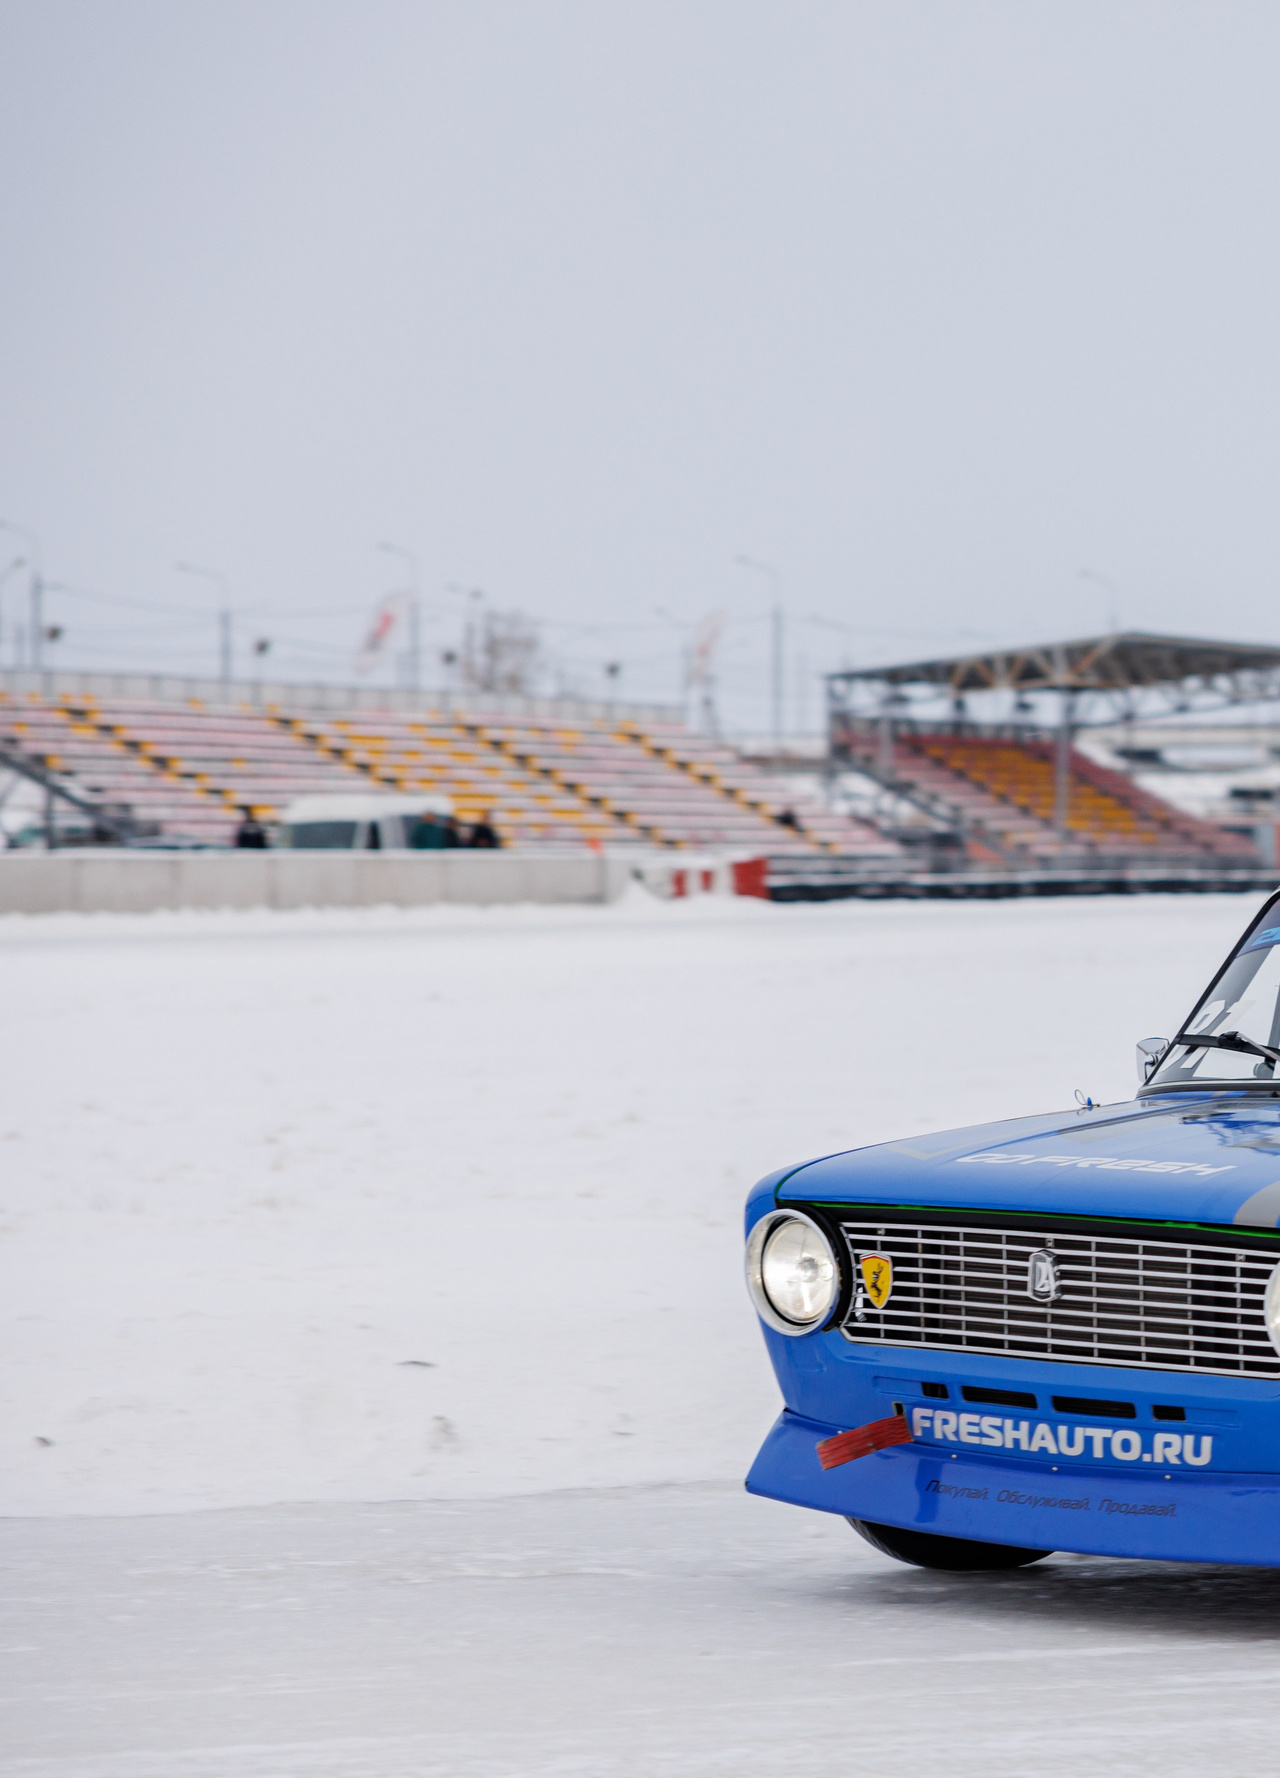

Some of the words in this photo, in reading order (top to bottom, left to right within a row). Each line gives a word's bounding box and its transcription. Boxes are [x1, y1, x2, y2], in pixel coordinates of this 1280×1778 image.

[912, 1406, 1213, 1467] FRESHAUTO.RU
[925, 1479, 989, 1502] Покупай.
[996, 1488, 1091, 1511] Обслуживай.
[1098, 1498, 1177, 1518] Продавай.
